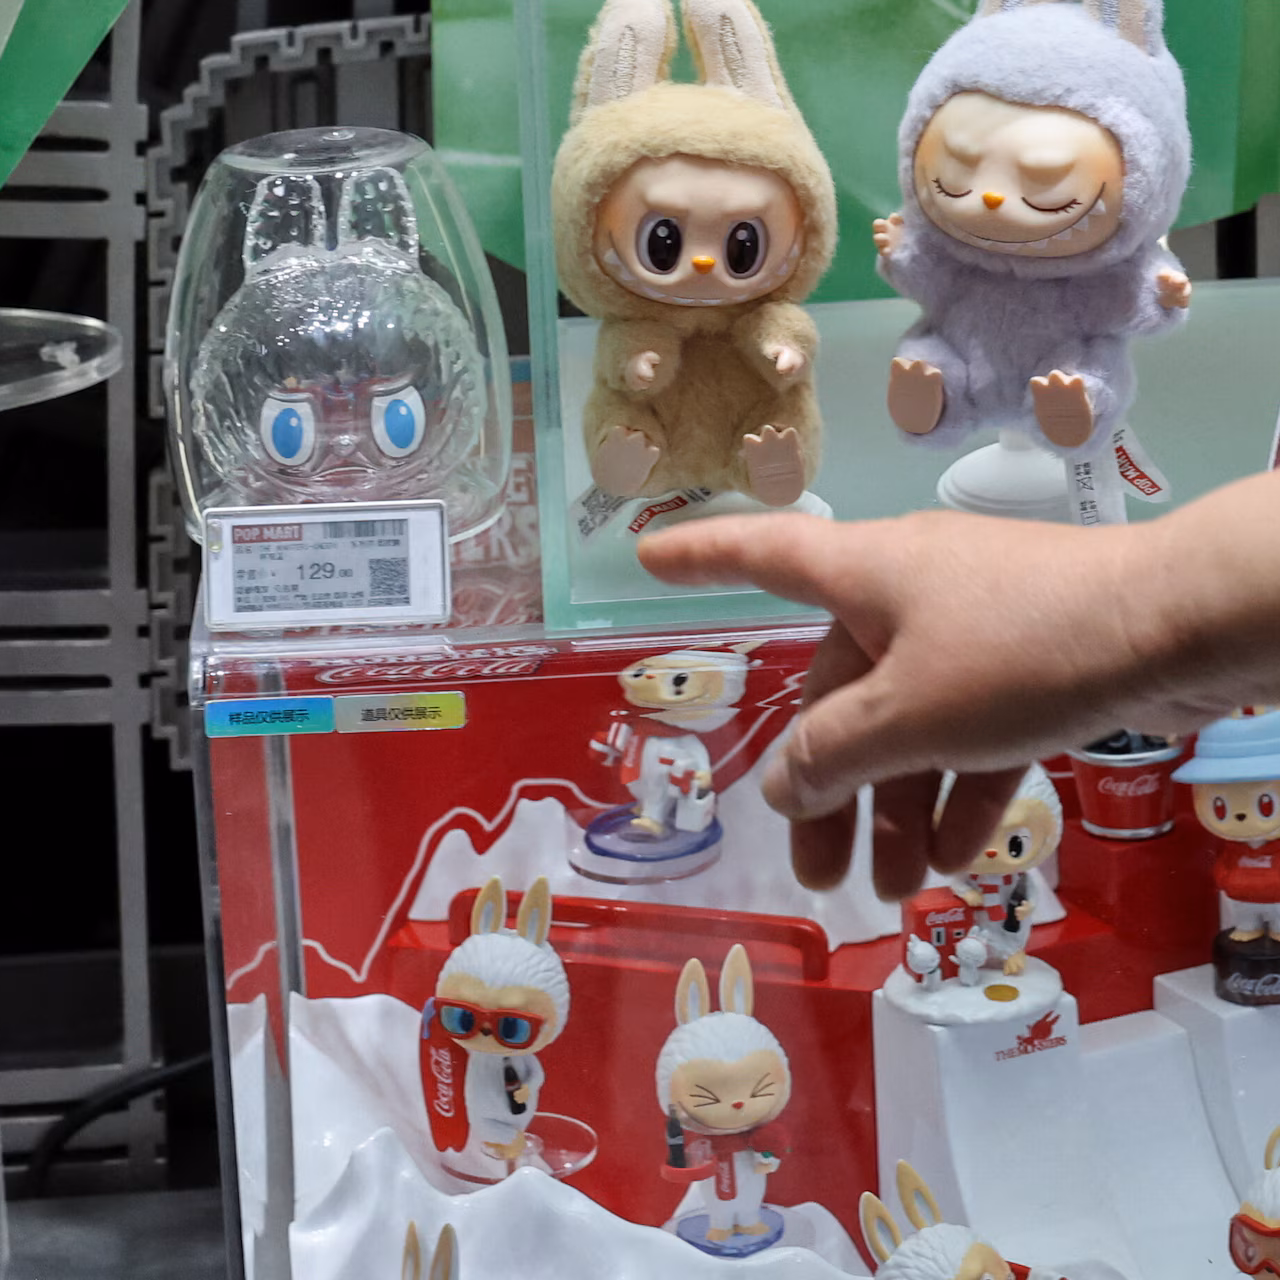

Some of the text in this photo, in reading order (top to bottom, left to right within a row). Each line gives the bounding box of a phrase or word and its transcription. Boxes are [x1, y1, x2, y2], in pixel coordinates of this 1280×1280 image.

[1133, 477, 1160, 494] POP
[630, 509, 652, 532] POP
[650, 496, 684, 514] MART
[233, 525, 301, 542] POP MART
[228, 708, 311, 726] 样品仅供展示
[361, 706, 443, 723] 道具仅供展示
